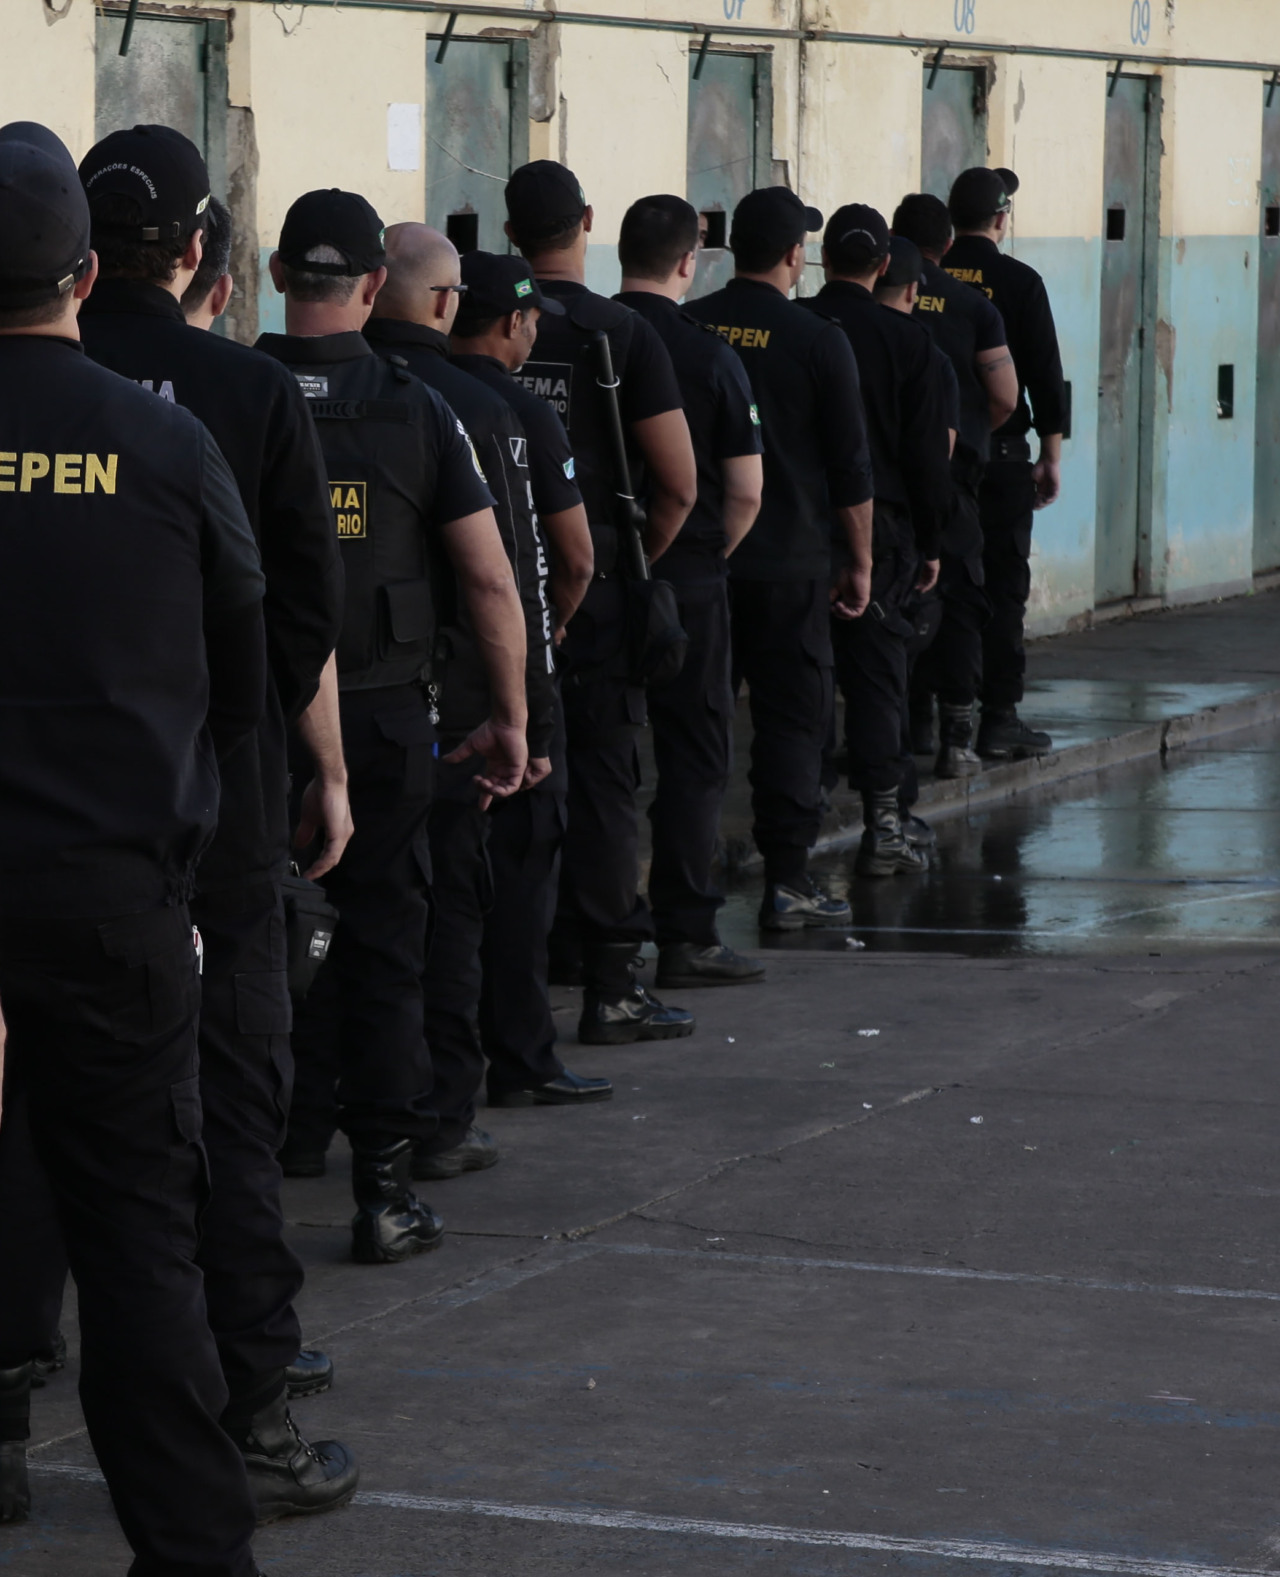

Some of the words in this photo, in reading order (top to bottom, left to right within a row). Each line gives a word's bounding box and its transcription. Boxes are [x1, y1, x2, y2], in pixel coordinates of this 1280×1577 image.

[1130, 0, 1150, 46] 09
[87, 162, 128, 188] OPERAÇÕES
[130, 165, 158, 200] ESPECIAIS
[337, 513, 362, 535] RIO
